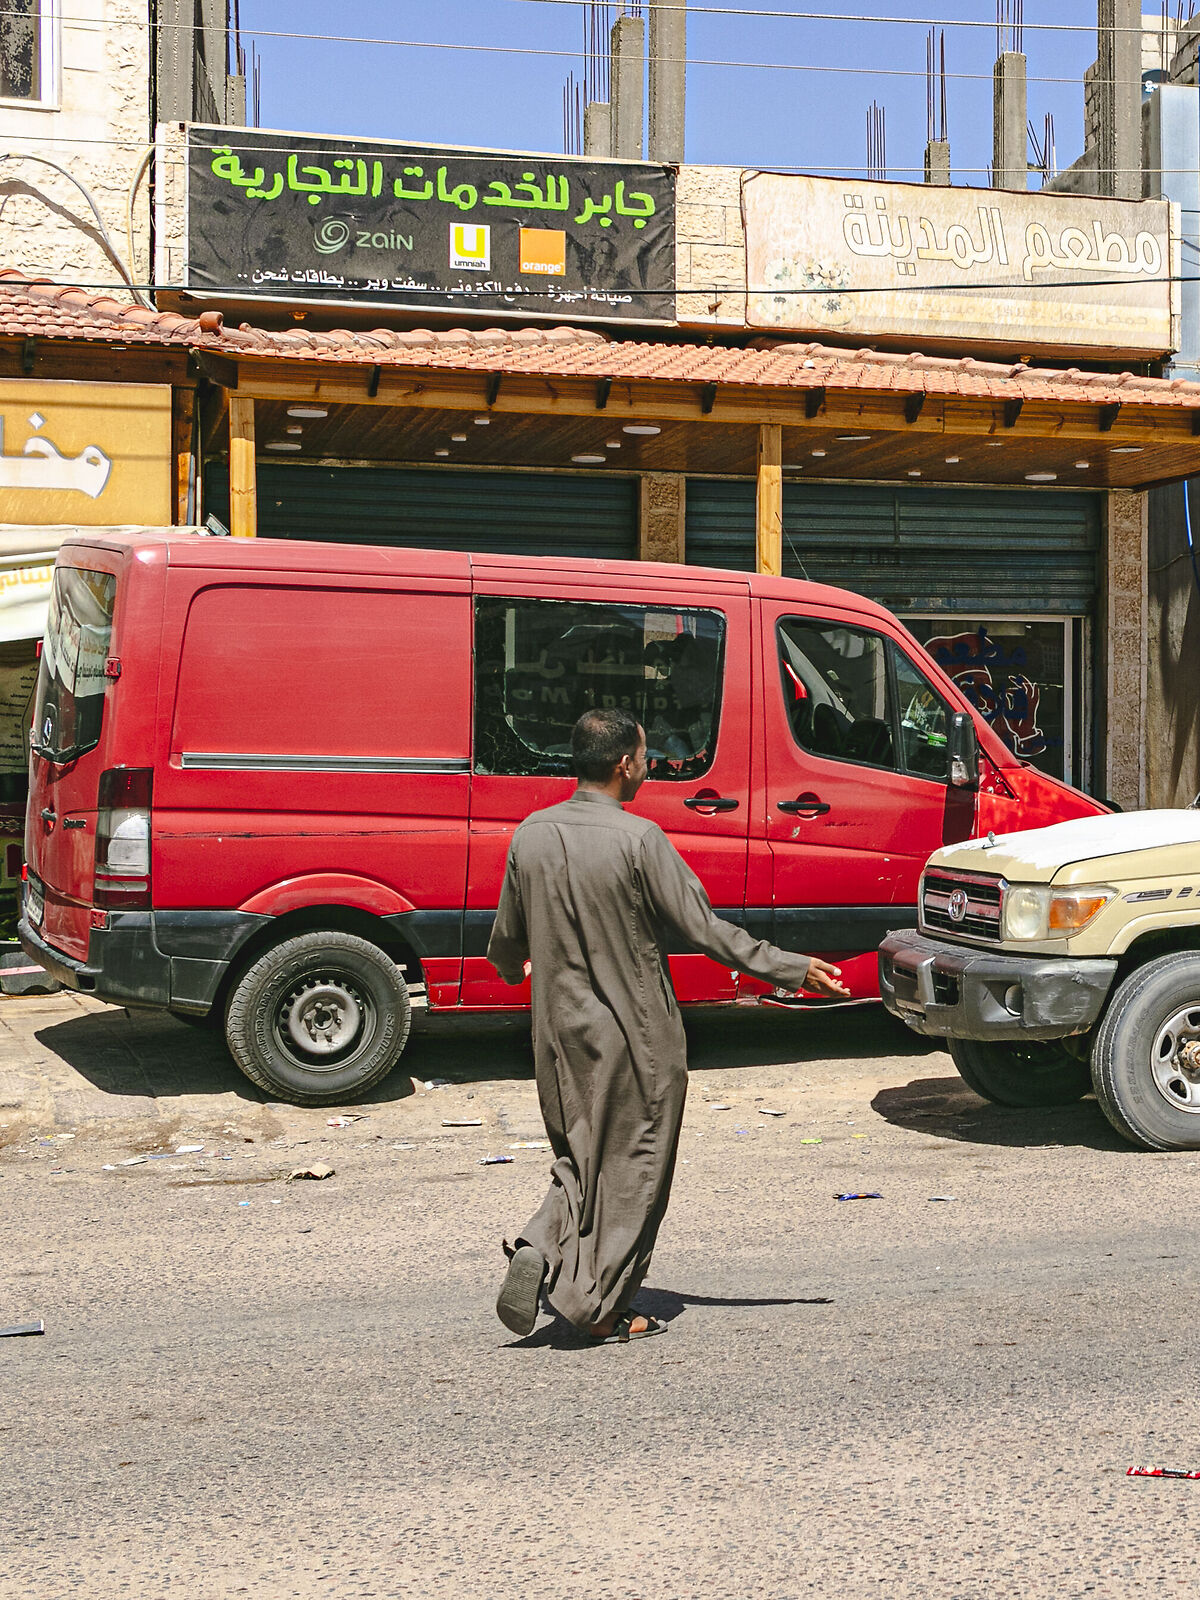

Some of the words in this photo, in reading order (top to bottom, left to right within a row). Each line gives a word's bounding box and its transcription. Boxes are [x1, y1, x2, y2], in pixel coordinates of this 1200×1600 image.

[211, 144, 383, 205] التجارية
[393, 166, 570, 211] للخدمات
[574, 180, 656, 229] جابر
[843, 193, 1009, 276] المدينة
[454, 260, 486, 268] umniah
[1022, 220, 1162, 281] مطعم
[252, 266, 289, 284] شحن
[291, 269, 345, 287] بطاقات
[364, 278, 389, 292] وير
[391, 276, 427, 291] سفت
